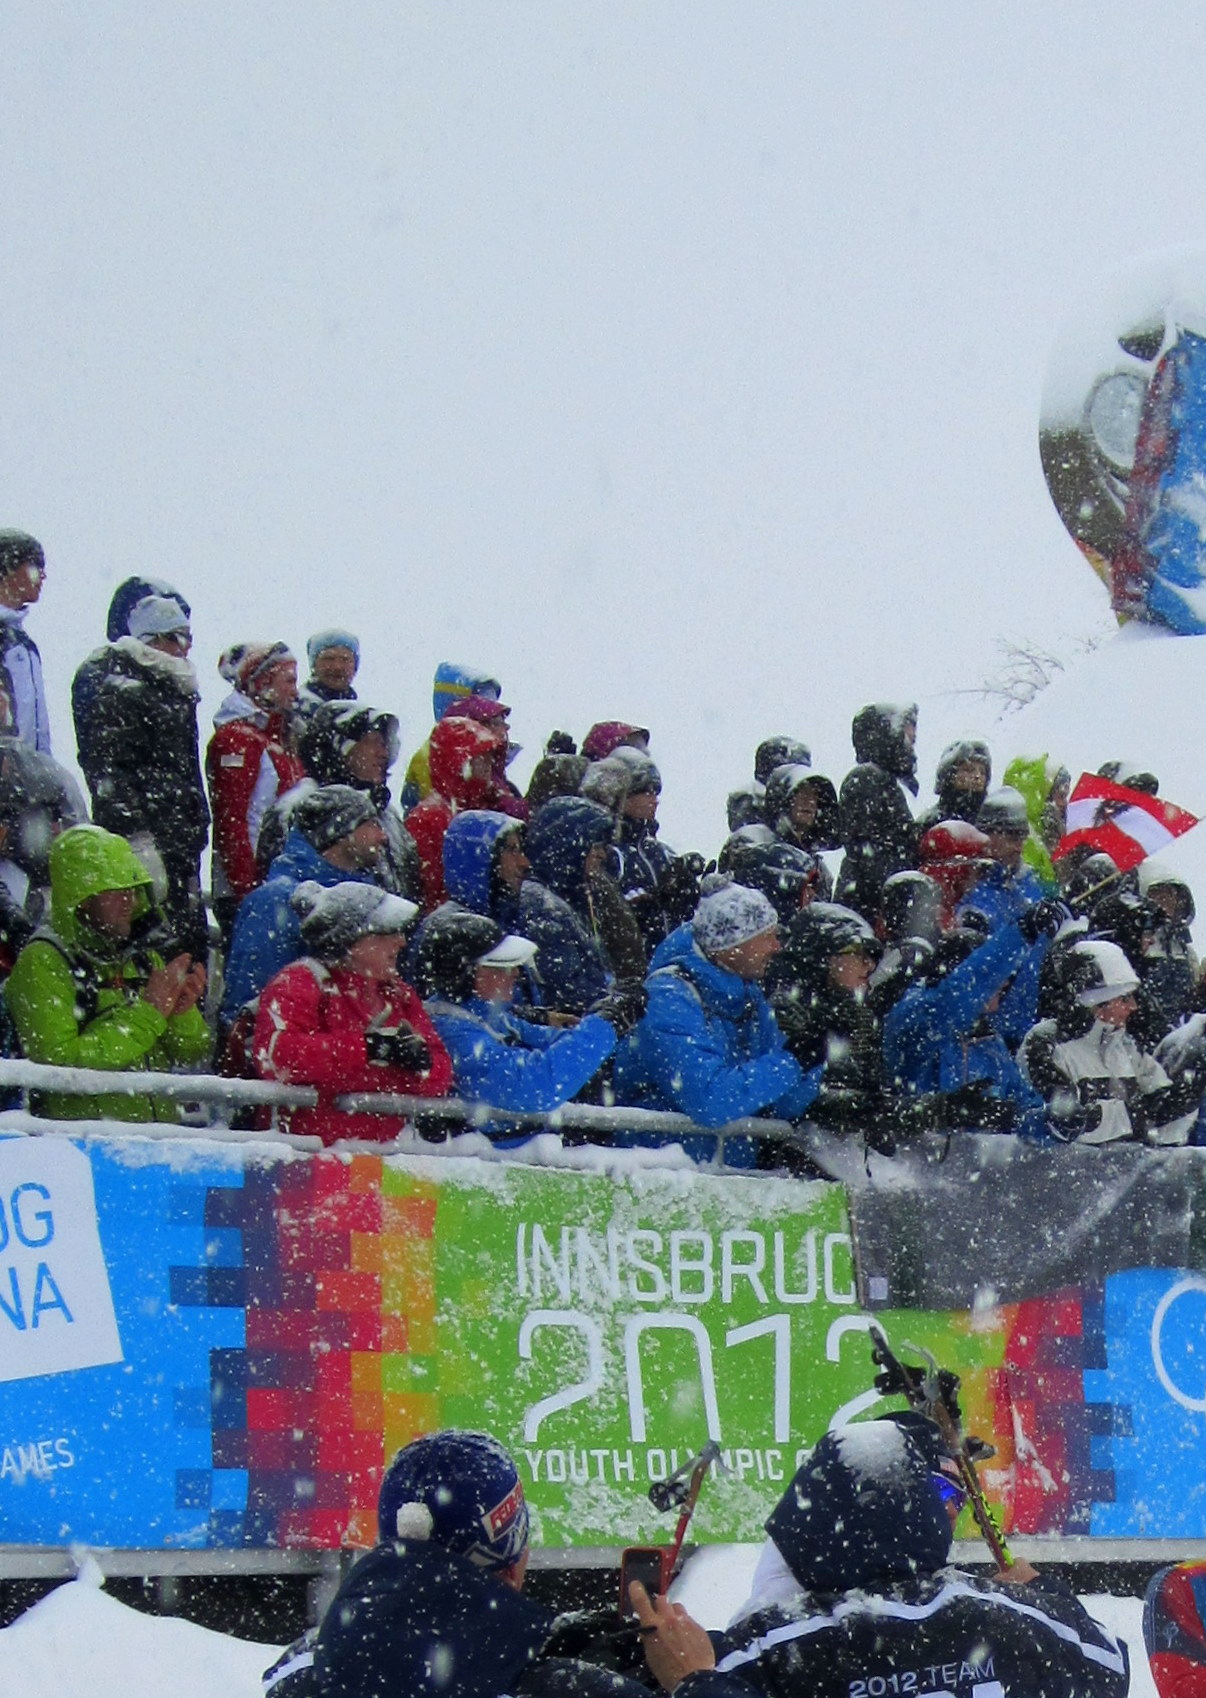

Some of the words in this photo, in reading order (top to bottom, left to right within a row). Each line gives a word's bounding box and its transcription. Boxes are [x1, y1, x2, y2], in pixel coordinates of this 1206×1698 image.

[516, 1222, 857, 1304] INNSBRUC
[518, 1309, 890, 1443] 2012
[524, 1449, 635, 1484] YOUTH
[924, 1656, 996, 1688] TEAM
